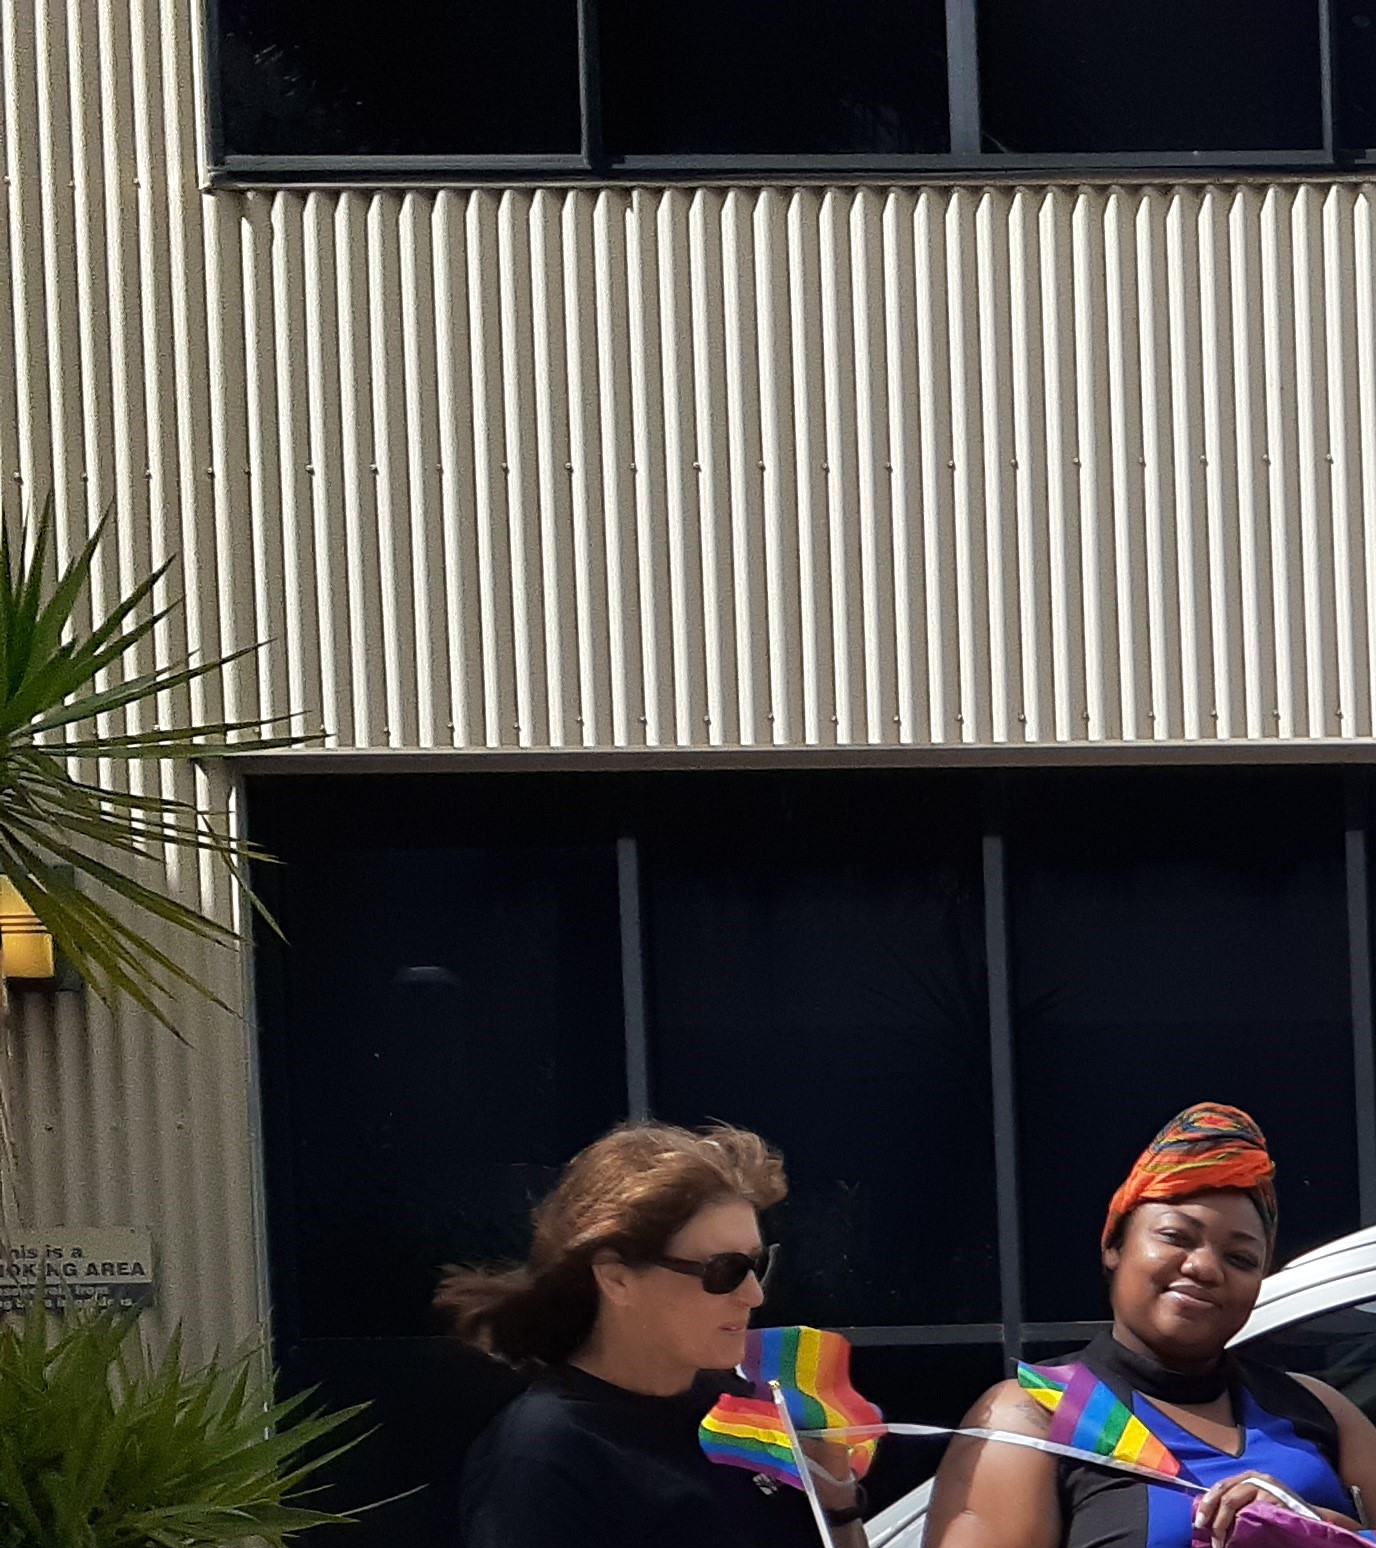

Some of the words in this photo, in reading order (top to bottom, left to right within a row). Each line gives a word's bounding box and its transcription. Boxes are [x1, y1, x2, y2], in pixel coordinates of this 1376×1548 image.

[45, 1245, 63, 1258] is
[71, 1248, 82, 1258] a
[84, 1262, 145, 1276] AREA
